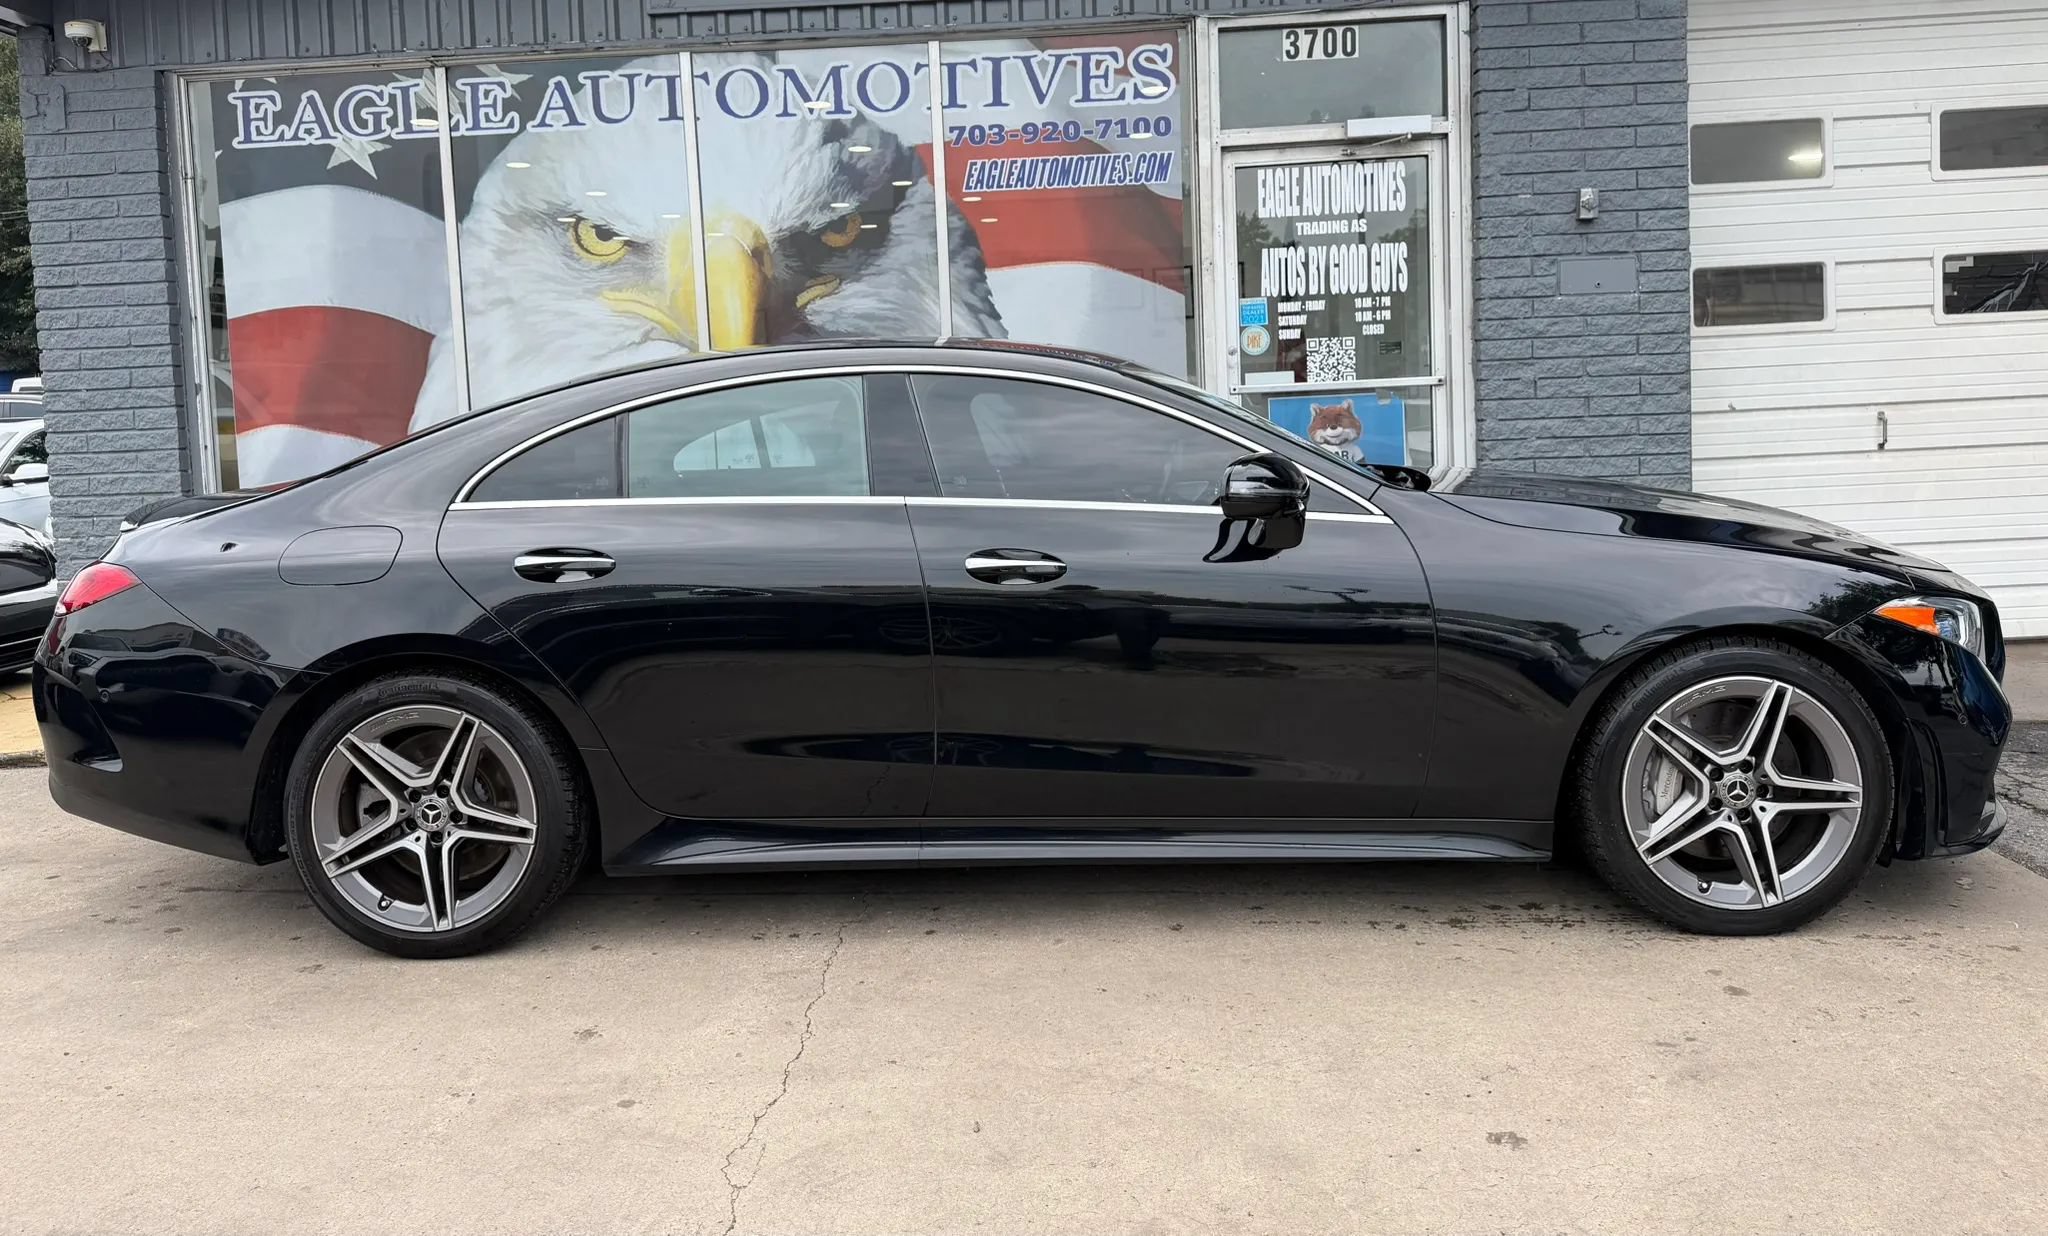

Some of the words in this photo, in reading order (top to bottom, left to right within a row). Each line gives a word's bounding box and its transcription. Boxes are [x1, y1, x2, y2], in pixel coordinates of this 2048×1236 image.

[1284, 27, 1357, 60] 3700
[228, 77, 520, 149] EAGLE
[526, 43, 1180, 133] AUTOMOTIVES
[948, 114, 1173, 147] 703-920-7100
[963, 150, 1175, 193] EAGLEAUTOMOTIVES.COM
[1257, 166, 1300, 218] EAGLE
[1302, 160, 1407, 217] AUTOMOTIVES
[1296, 220, 1349, 236] TRADING
[1350, 218, 1367, 234] AS
[1261, 246, 1306, 297] AUTOS
[1308, 245, 1328, 295] BY
[1329, 243, 1368, 295] GOOD
[1370, 241, 1408, 294] GUYS
[1278, 301, 1302, 313] MONDAY
[1306, 299, 1326, 312] FRIDAY
[1354, 297, 1362, 309] 10
[1362, 297, 1372, 308] AM
[1375, 296, 1380, 307] 7
[1381, 295, 1391, 307] PM
[1278, 314, 1307, 327] SATURDAY
[1354, 311, 1362, 322] 10
[1362, 310, 1372, 321] AM
[1376, 310, 1381, 321] 6
[1381, 309, 1391, 321] PM
[1278, 328, 1302, 340] SUNDAY
[1362, 323, 1385, 335] CLOSED
